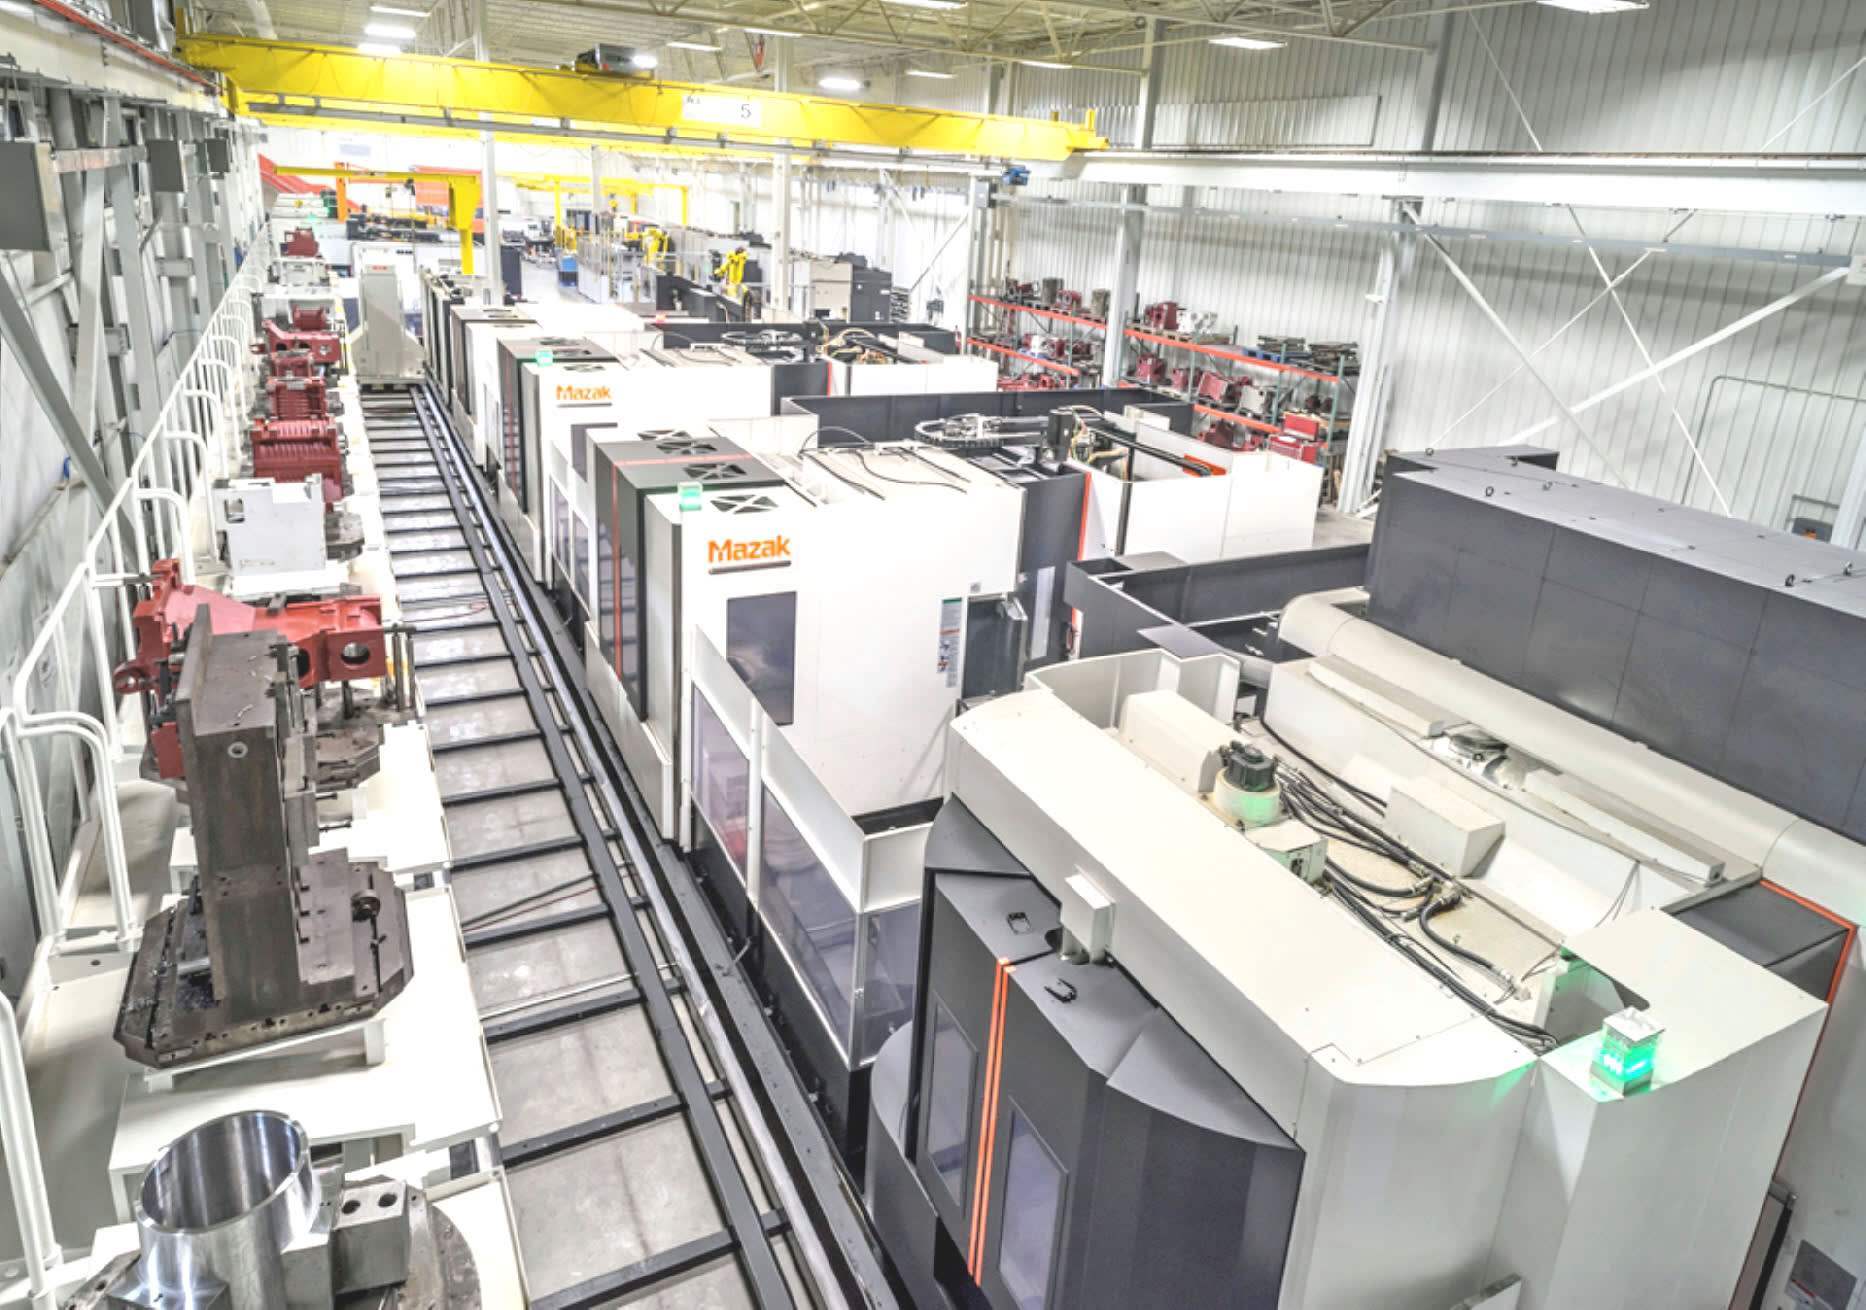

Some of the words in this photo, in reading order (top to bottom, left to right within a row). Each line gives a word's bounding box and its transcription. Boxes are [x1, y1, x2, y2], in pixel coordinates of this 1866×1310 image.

[741, 103, 752, 119] 5
[556, 384, 612, 400] Mazak
[707, 534, 790, 562] Mazak
